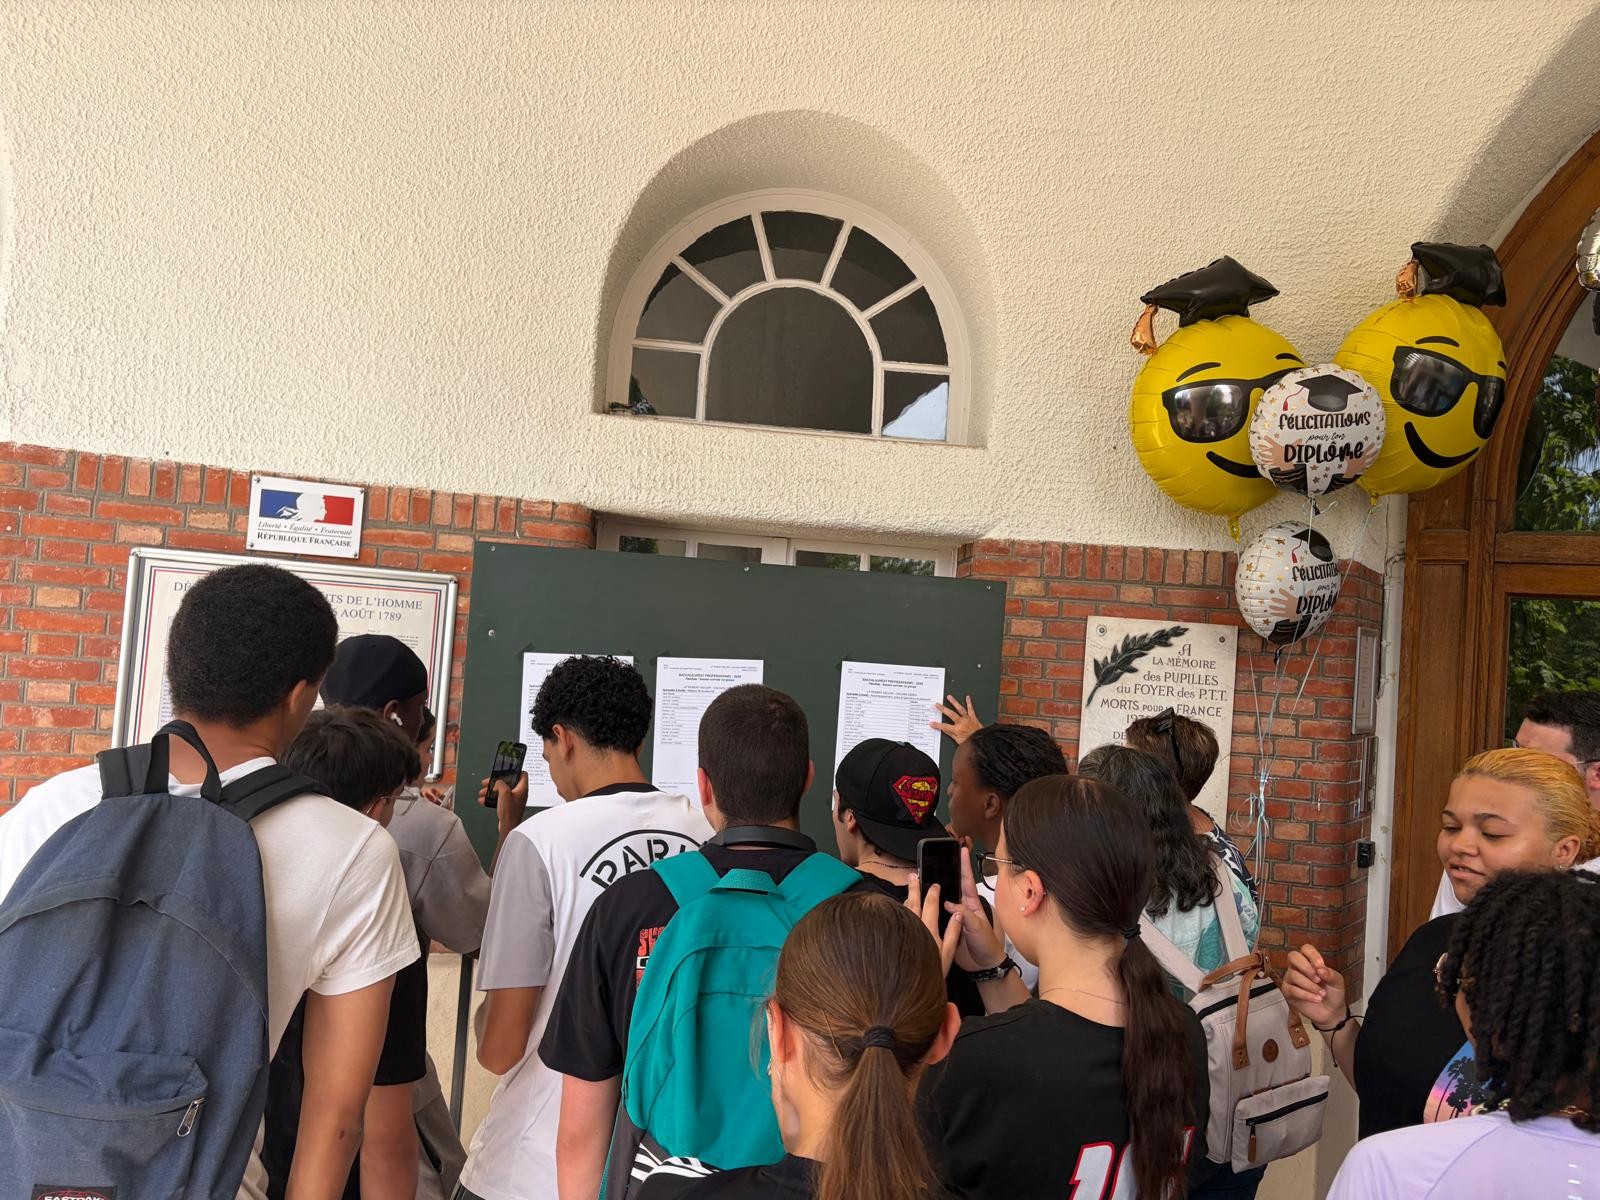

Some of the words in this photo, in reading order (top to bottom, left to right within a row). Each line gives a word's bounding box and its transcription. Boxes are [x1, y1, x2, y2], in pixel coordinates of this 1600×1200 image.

[1306, 434, 1330, 444] pour
[1331, 431, 1346, 441] ton
[258, 521, 282, 529] Liberté
[289, 524, 313, 532] Égalité
[320, 527, 353, 536] Fraternité
[257, 532, 308, 544] RÉPUBLIQUE
[309, 536, 352, 547] FRANÇAISE
[346, 595, 362, 605] DE
[366, 596, 423, 609] L'HOMME
[340, 608, 375, 619] AOÛT
[379, 611, 402, 621] 1789
[1152, 656, 1164, 666] LA
[1166, 656, 1217, 670] MÉMOIRE
[1143, 670, 1161, 682] des
[1164, 672, 1219, 686] PUPILLES
[1116, 682, 1131, 694] du
[1134, 683, 1175, 697] FOYER
[1177, 687, 1195, 699] des
[1198, 689, 1228, 702] P.T.T.
[1100, 698, 1140, 711] MORTS
[1142, 704, 1164, 712] POUR
[1176, 704, 1222, 717] FRANCE
[591, 839, 686, 889] PAR
